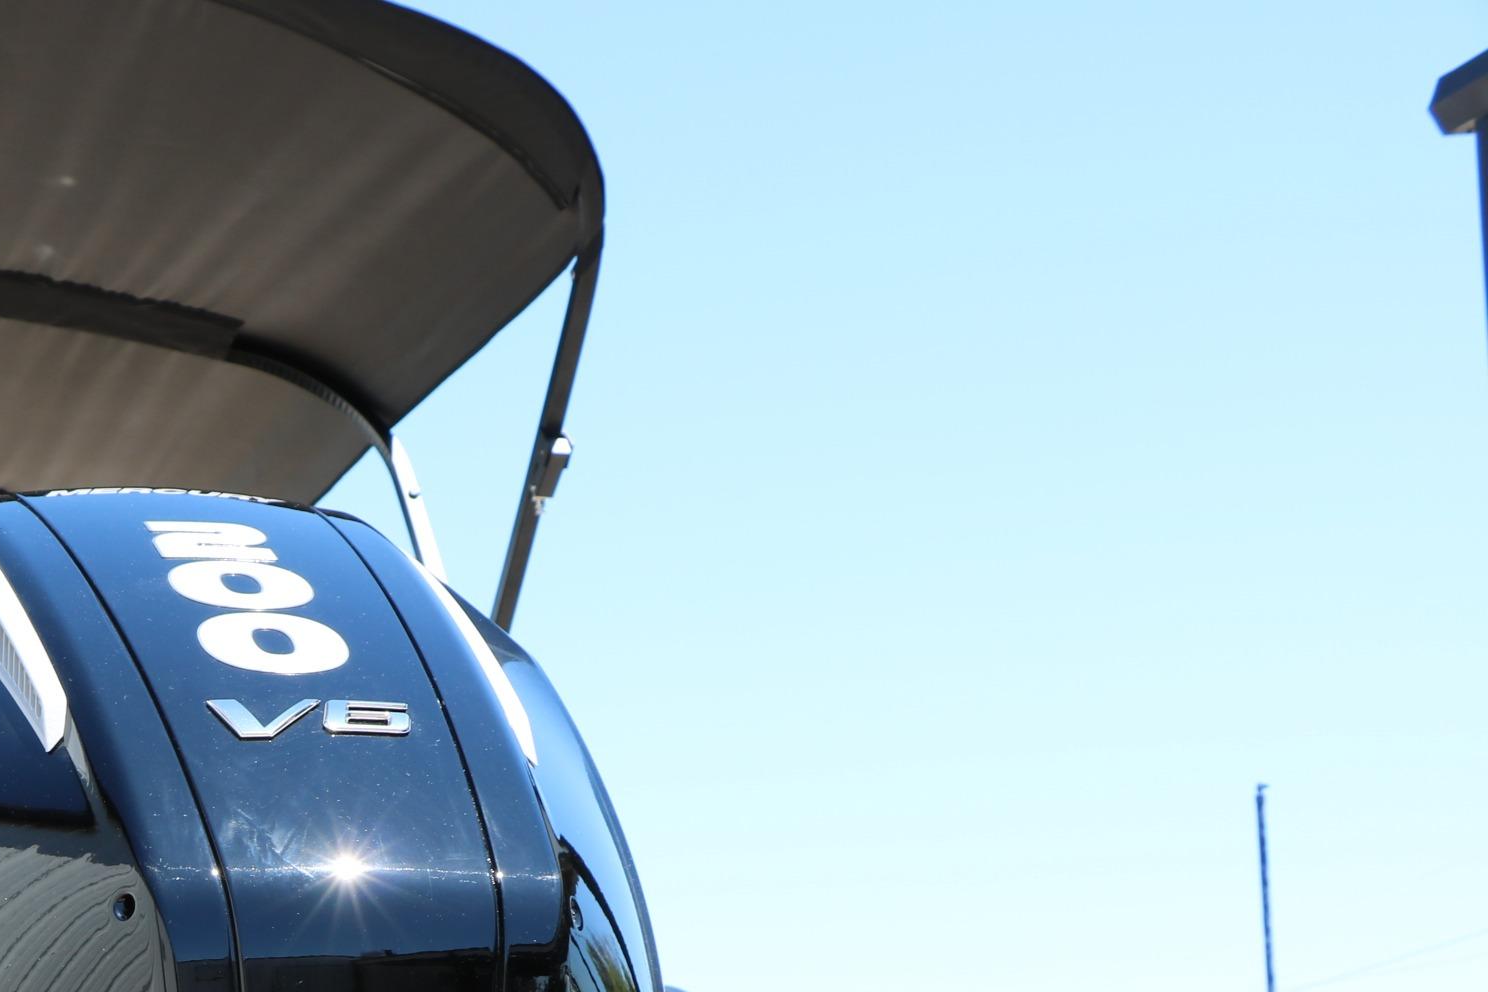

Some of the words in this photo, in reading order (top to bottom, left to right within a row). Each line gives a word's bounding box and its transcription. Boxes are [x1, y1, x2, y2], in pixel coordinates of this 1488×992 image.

[44, 486, 288, 504] MERCURY
[143, 520, 351, 676] 200
[206, 698, 413, 741] V6
